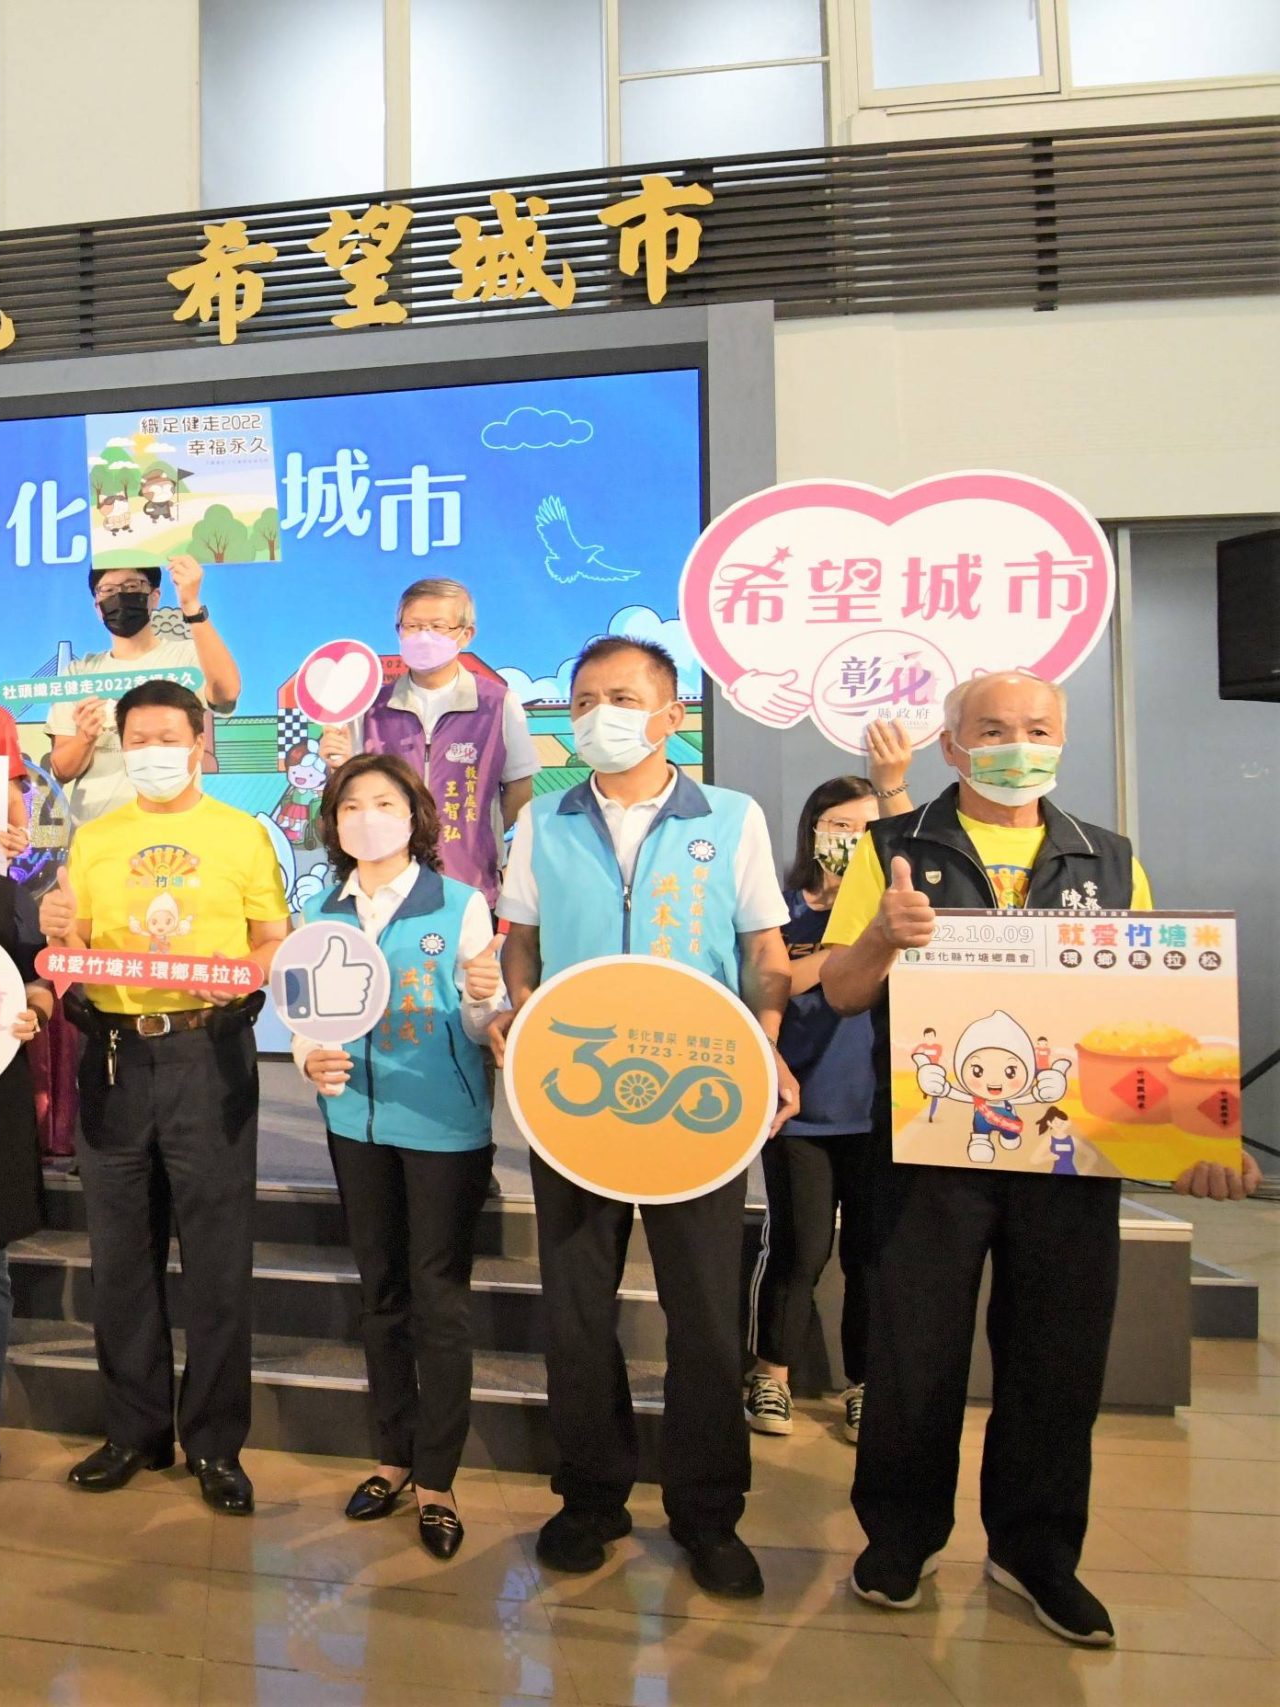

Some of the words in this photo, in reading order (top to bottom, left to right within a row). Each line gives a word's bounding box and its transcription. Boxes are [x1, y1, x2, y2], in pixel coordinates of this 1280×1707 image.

[167, 174, 715, 346] 希望城市
[141, 414, 262, 434] 織足健走2022
[188, 437, 268, 456] 幸福永久
[713, 545, 1094, 625] 希望城市
[839, 655, 932, 706] 彰化
[878, 707, 931, 720] 縣政府
[443, 780, 462, 844] 王智弘
[1061, 888, 1086, 910] 陳
[1057, 923, 1221, 948] 就愛竹塘米
[47, 952, 144, 978] 就愛竹塘米
[150, 961, 252, 986] 環鄉馬拉松
[924, 951, 1030, 964] 彰化縣竹塘鄉農會
[1060, 950, 1220, 969] 環鄉馬拉松
